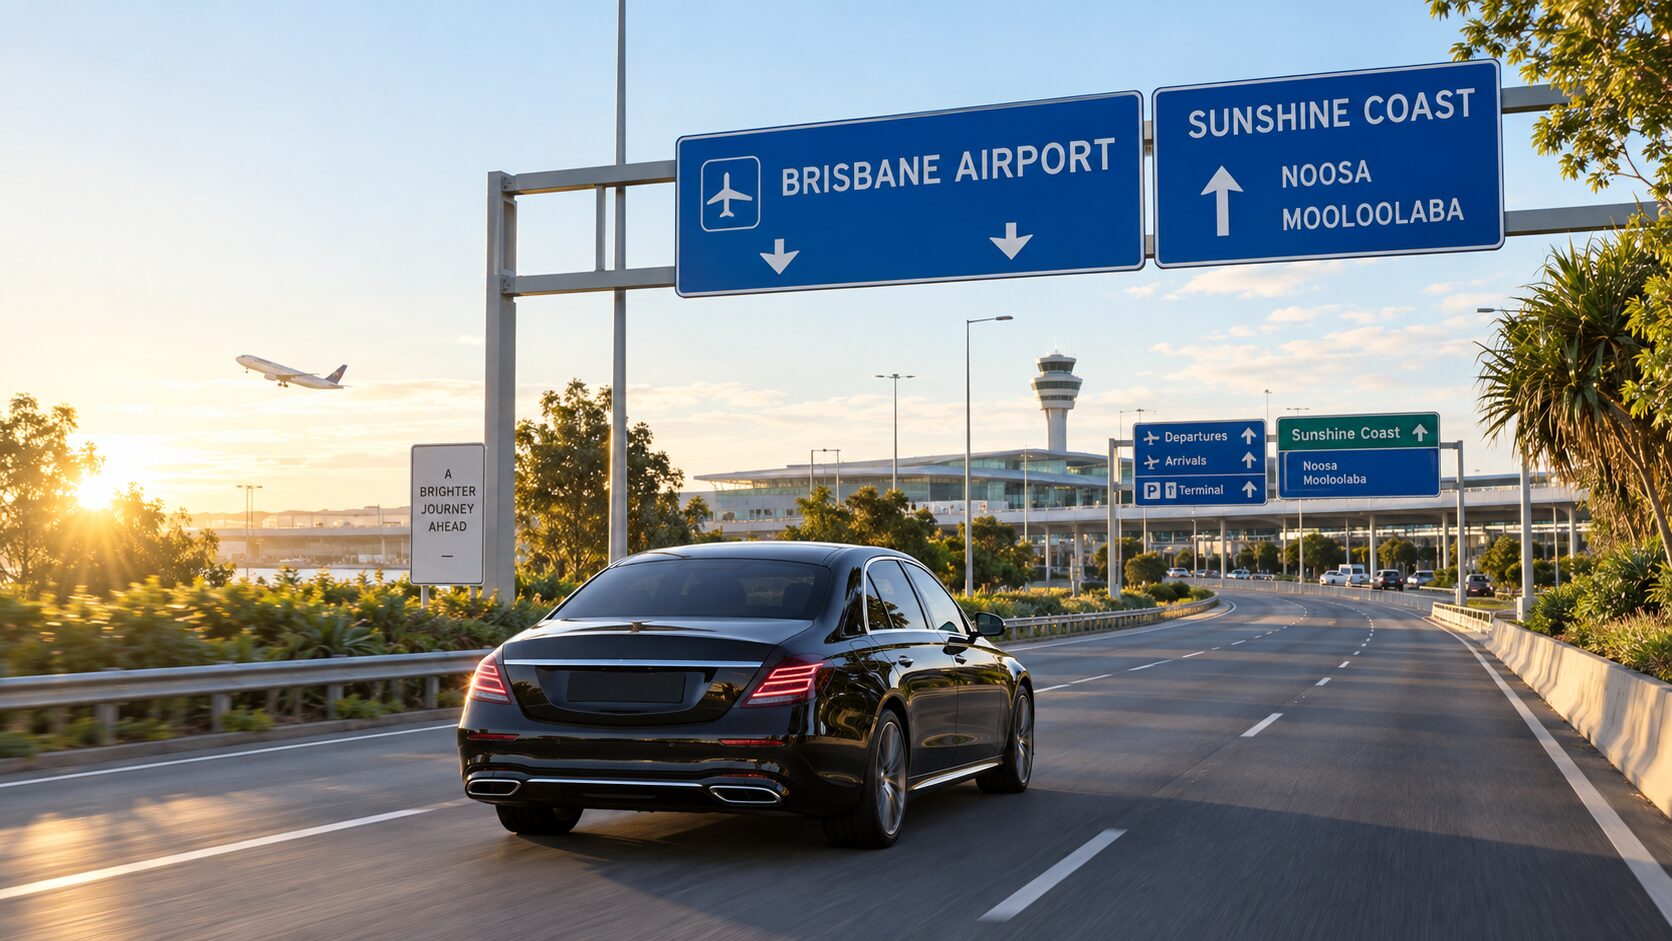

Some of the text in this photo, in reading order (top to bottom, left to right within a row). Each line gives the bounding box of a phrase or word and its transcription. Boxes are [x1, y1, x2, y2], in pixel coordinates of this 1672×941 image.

[1188, 87, 1476, 139] SUNSHINE COAST
[782, 137, 1116, 197] BRISBANE AIRPORT
[1282, 159, 1373, 188] NOOSA
[1282, 197, 1465, 231] MOOLOOLABA
[1165, 431, 1228, 445] Departures
[1291, 426, 1401, 442] Sunshine Coast
[1165, 455, 1207, 467] Arrivals
[1303, 460, 1338, 472] Noosa
[444, 468, 452, 480] A
[1303, 473, 1367, 486] Mooloolaba
[419, 485, 477, 498] BRIGHTER
[1147, 484, 1224, 498] P Terminal
[420, 503, 475, 515] JOURNEY
[428, 520, 467, 532] AHEAD
